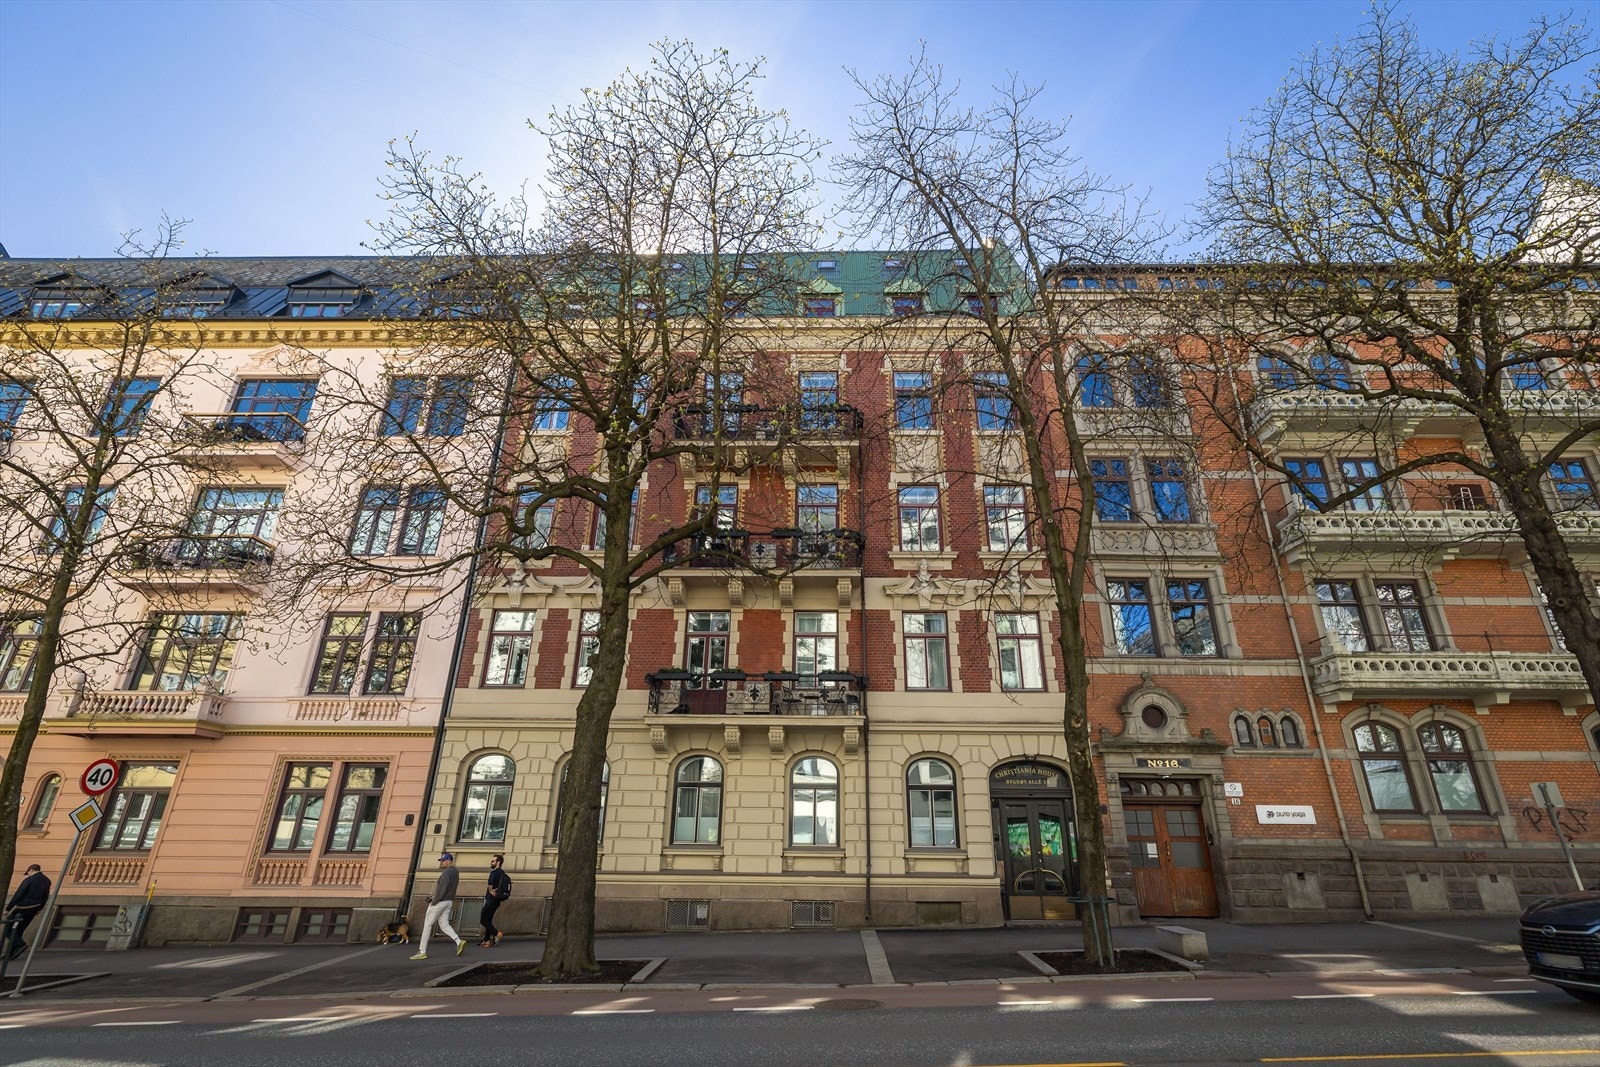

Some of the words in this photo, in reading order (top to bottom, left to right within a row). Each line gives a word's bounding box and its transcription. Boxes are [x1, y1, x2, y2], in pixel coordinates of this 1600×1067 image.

[87, 768, 113, 786] 40
[994, 768, 1036, 778] CHRISTIANIA
[1038, 768, 1059, 778] HOUSE
